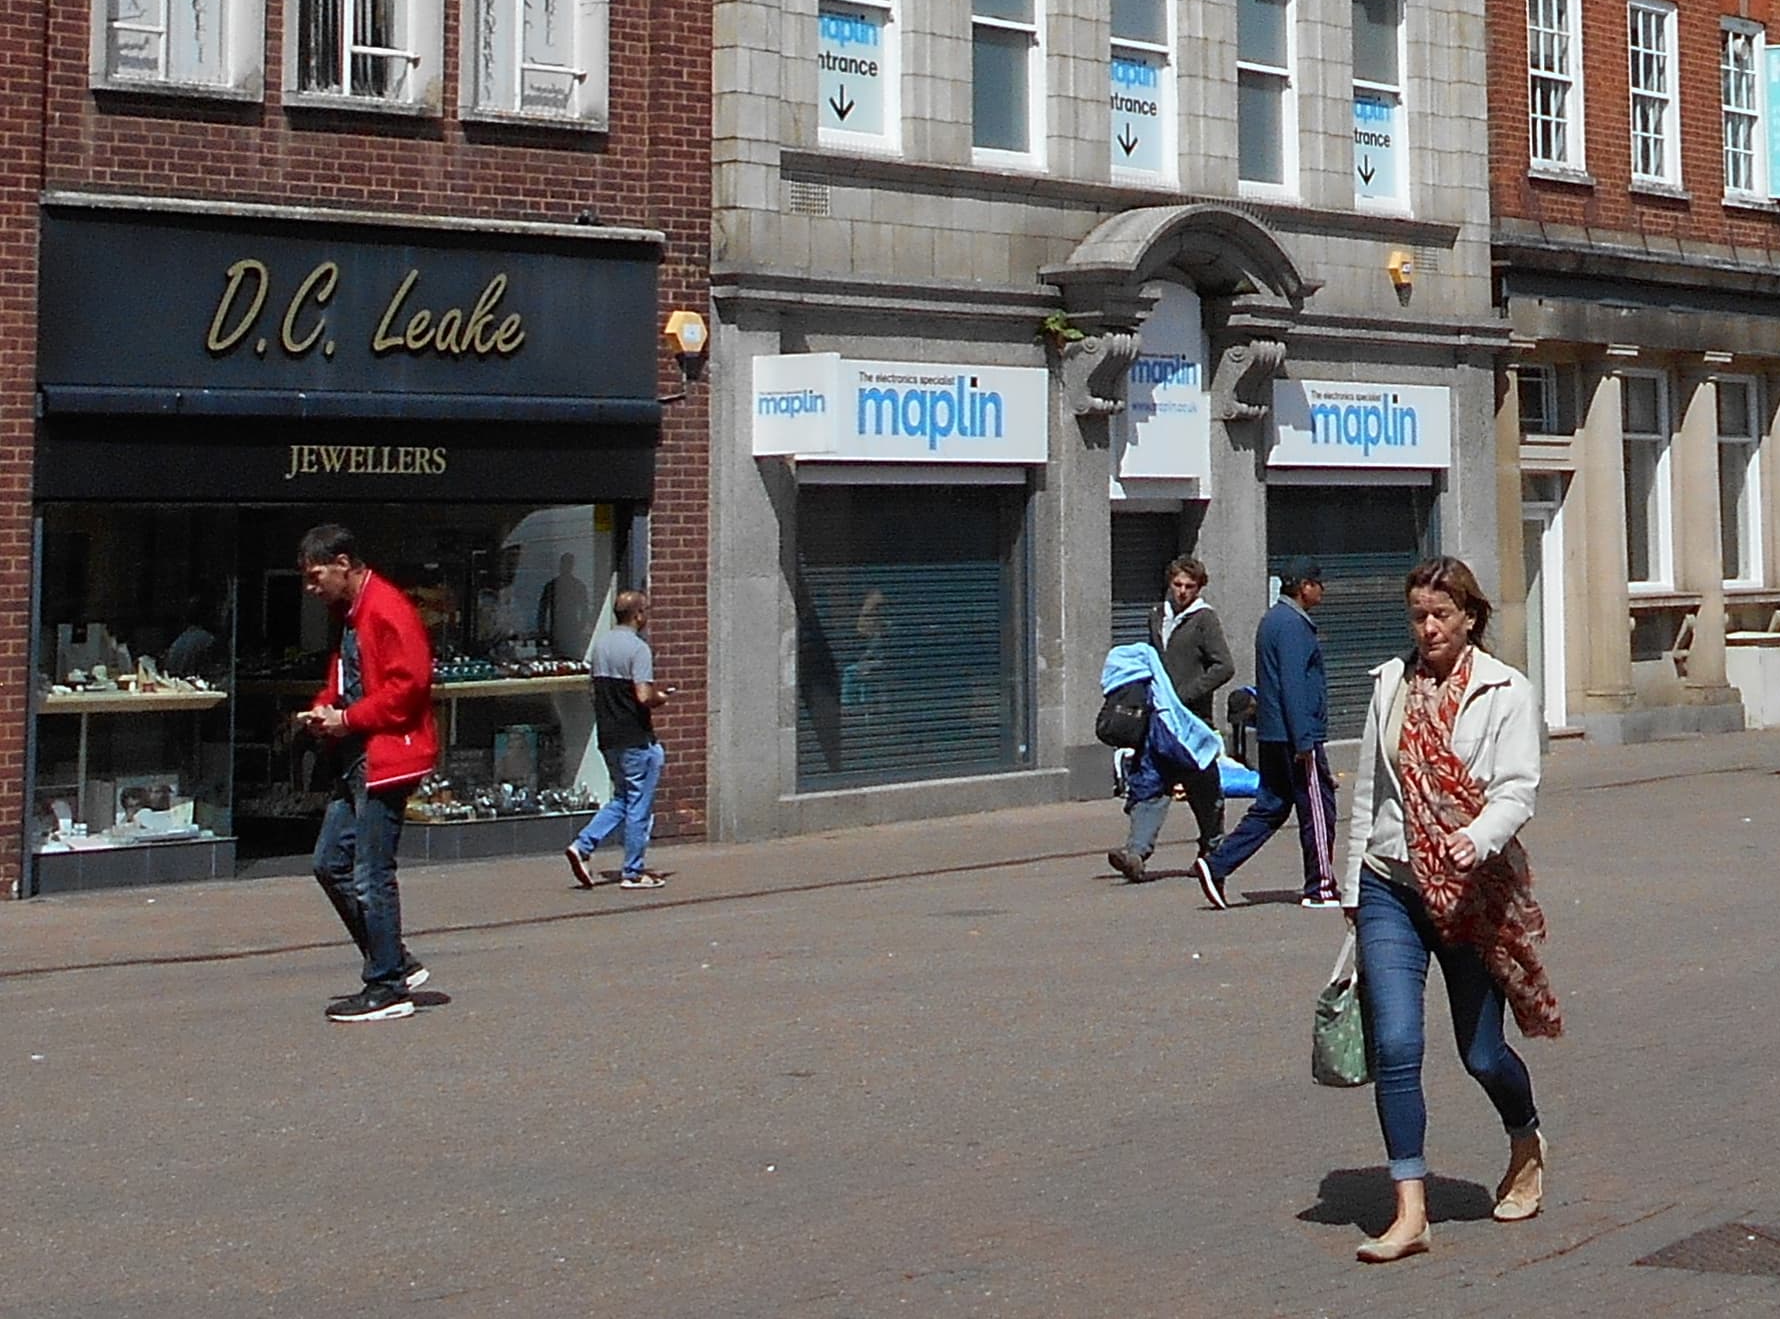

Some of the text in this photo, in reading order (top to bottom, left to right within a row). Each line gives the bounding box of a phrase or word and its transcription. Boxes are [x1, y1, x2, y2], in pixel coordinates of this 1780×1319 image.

[372, 268, 527, 355] Leake
[859, 371, 956, 386] The electronics specialist
[1131, 353, 1197, 391] maplin
[758, 389, 826, 418] maplin
[858, 375, 1003, 450] maplin
[1311, 393, 1417, 457] maplin
[285, 444, 447, 480] JEWELLERS
